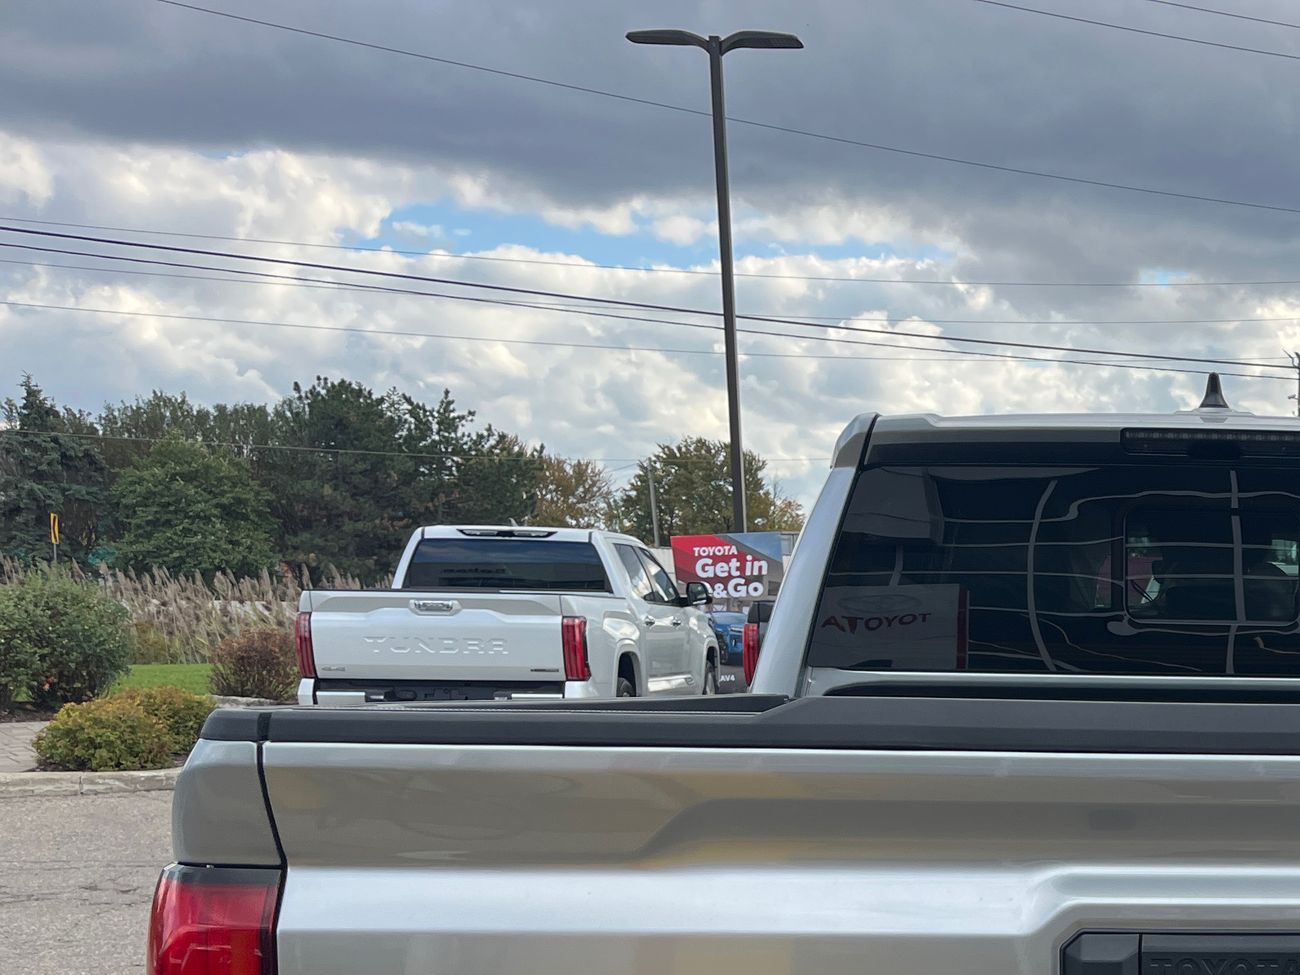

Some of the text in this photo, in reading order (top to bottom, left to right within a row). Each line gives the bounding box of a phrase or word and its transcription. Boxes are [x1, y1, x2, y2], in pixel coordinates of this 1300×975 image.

[693, 546, 738, 556] TOYOTA
[695, 554, 768, 578] Get in
[363, 636, 509, 655] TUNDRA
